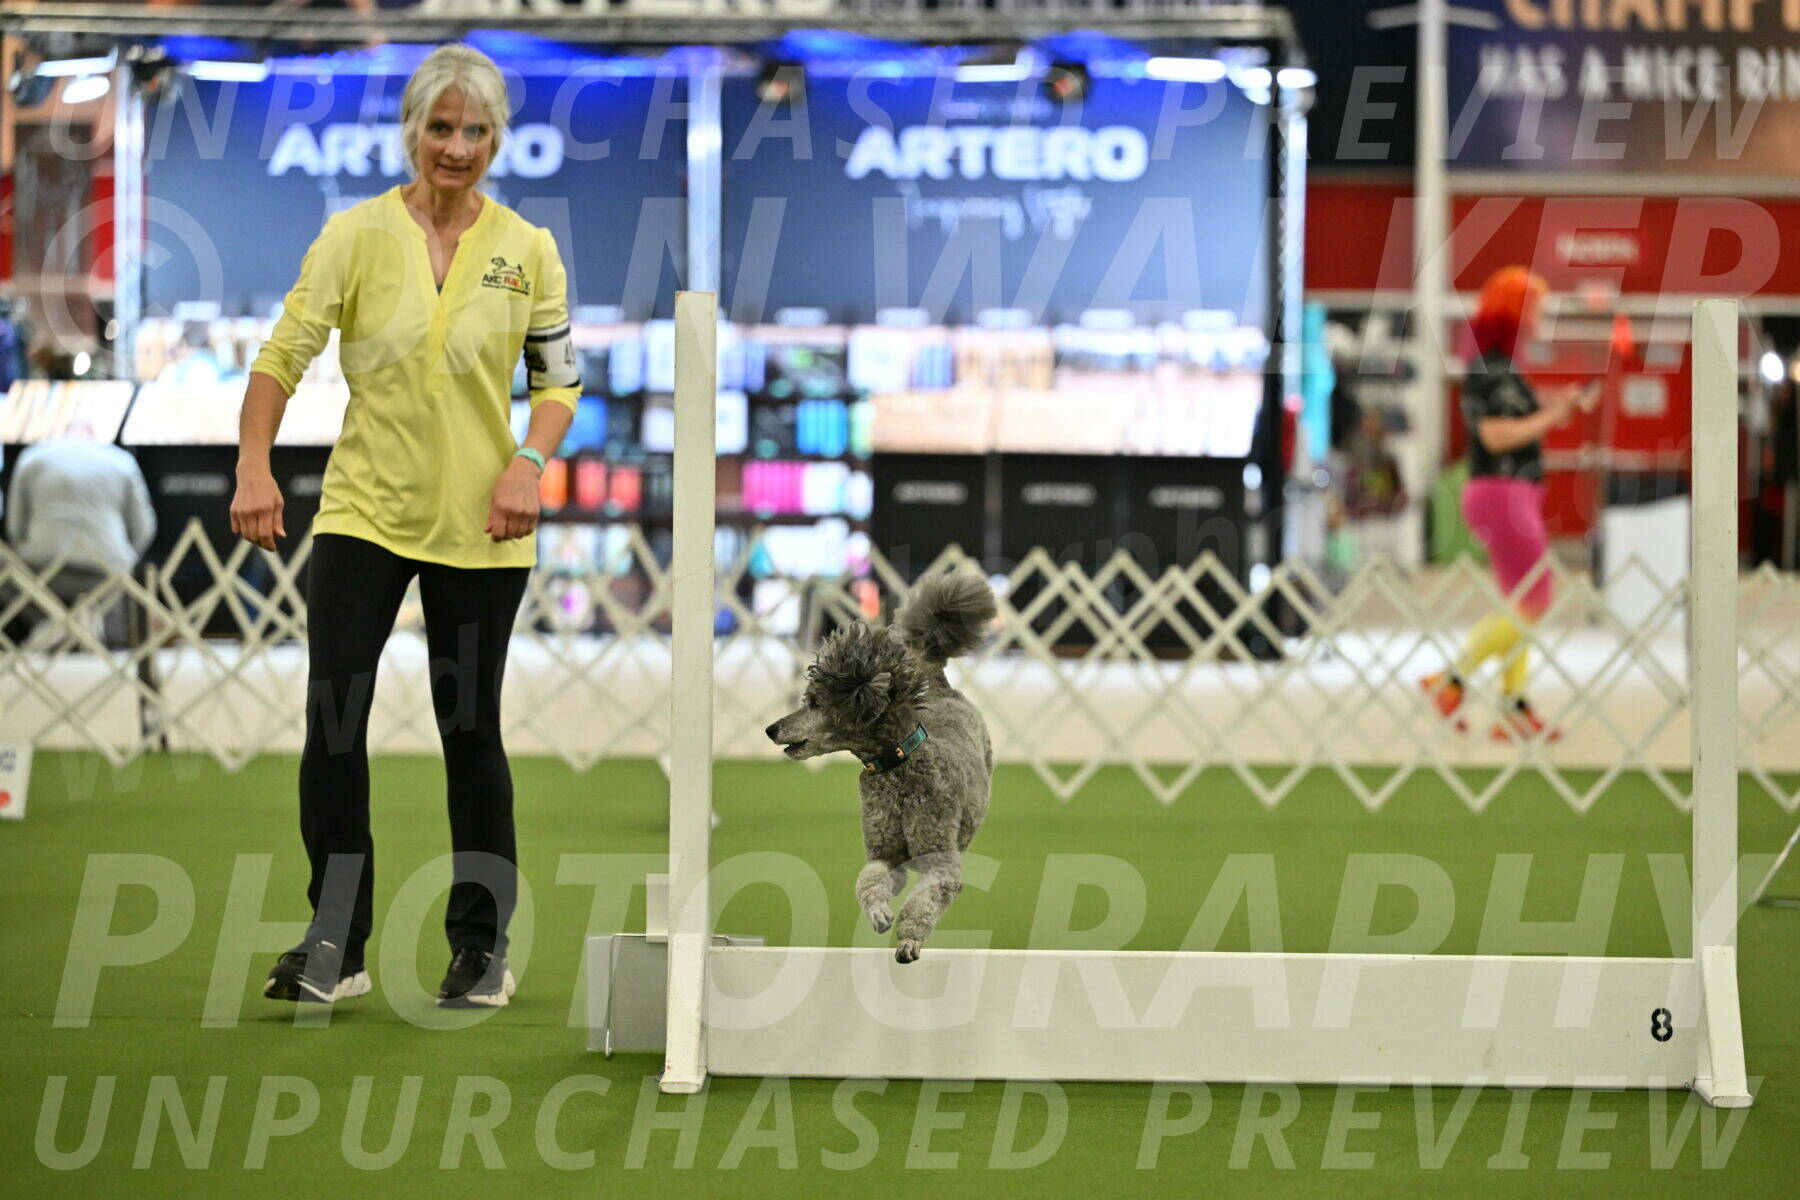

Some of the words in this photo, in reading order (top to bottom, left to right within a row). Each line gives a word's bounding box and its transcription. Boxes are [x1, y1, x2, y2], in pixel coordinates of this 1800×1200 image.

[268, 121, 565, 178] ARTO
[844, 123, 1150, 181] ARTERO
[1651, 1008, 1673, 1042] 8
